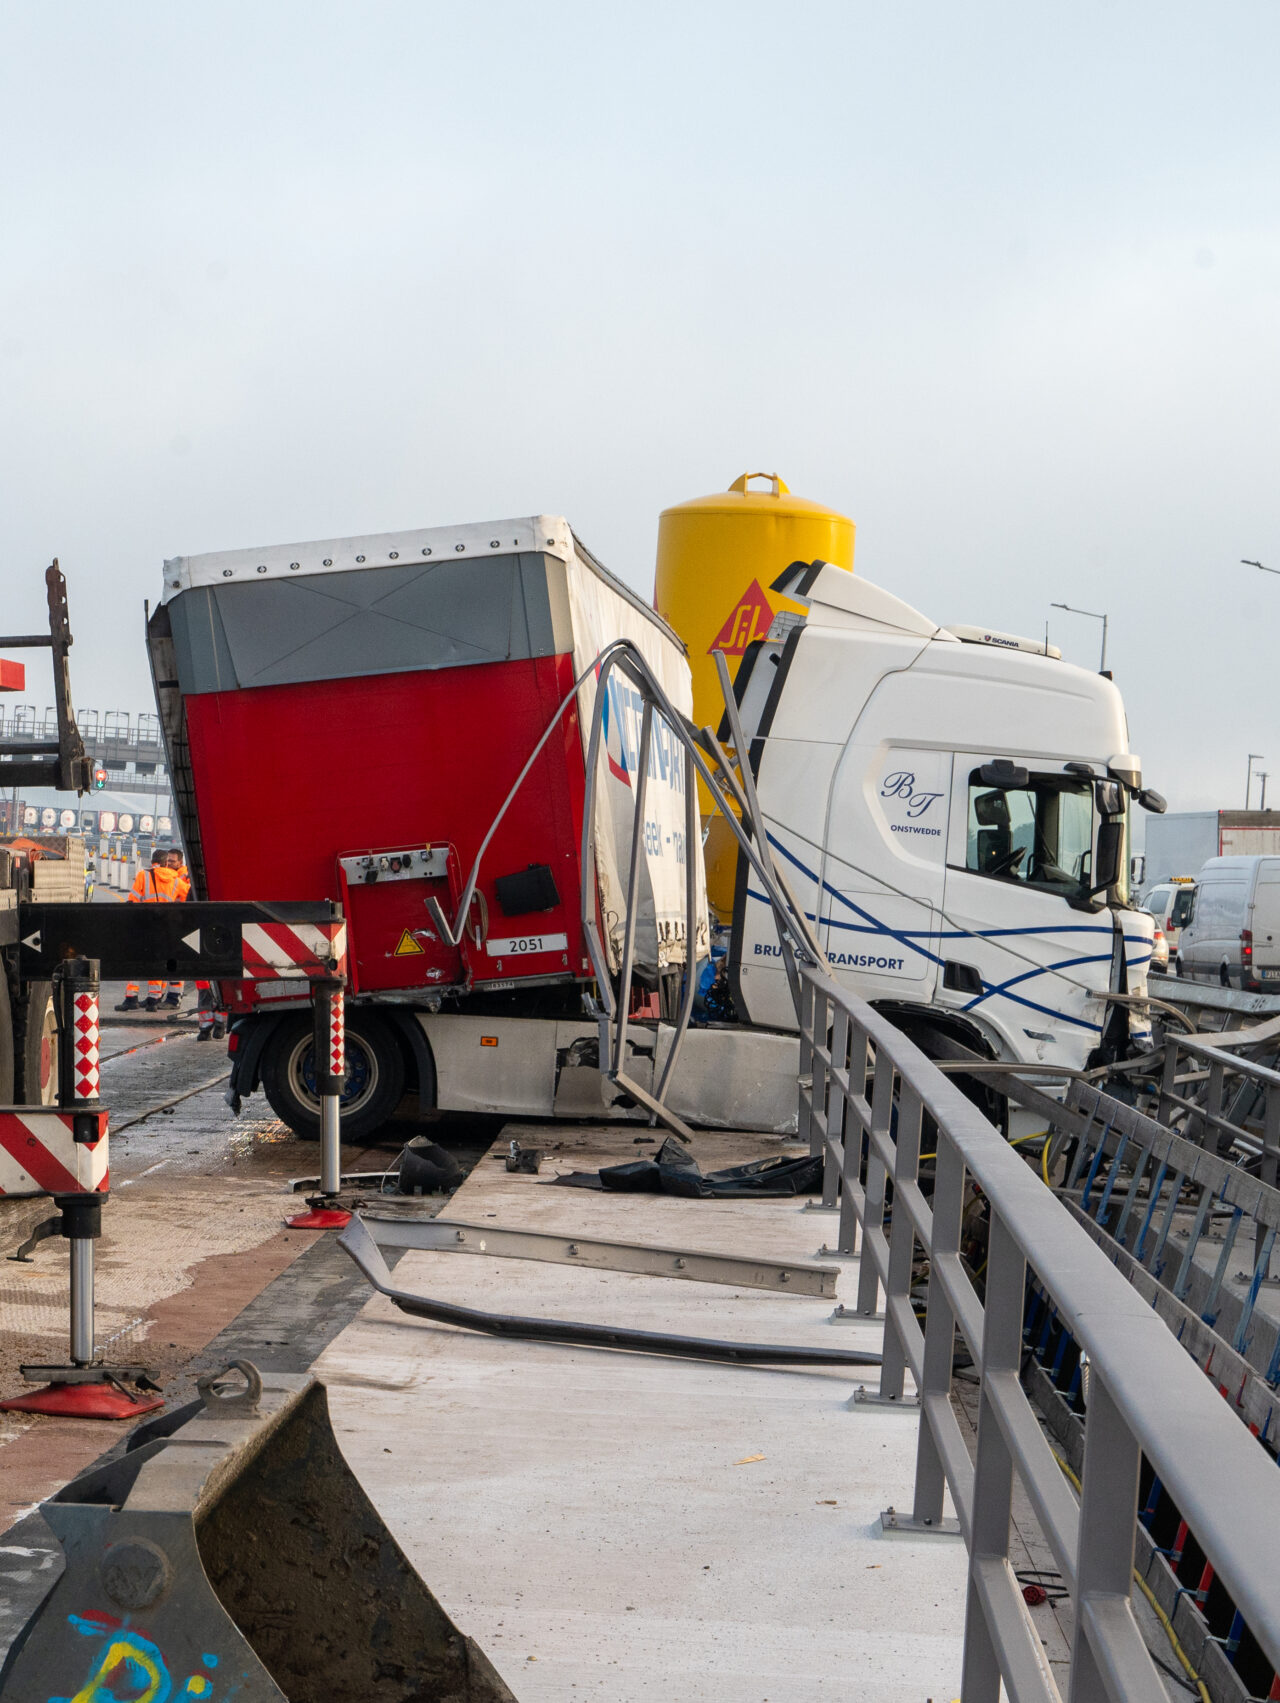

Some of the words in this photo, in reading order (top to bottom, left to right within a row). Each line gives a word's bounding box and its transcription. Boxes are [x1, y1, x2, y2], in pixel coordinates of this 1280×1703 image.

[718, 605, 765, 649] Sik
[991, 637, 1019, 648] SCANIA
[890, 824, 942, 836] ONSTWEDDE
[509, 938, 543, 953] 2051
[823, 951, 905, 970] RANSPORT
